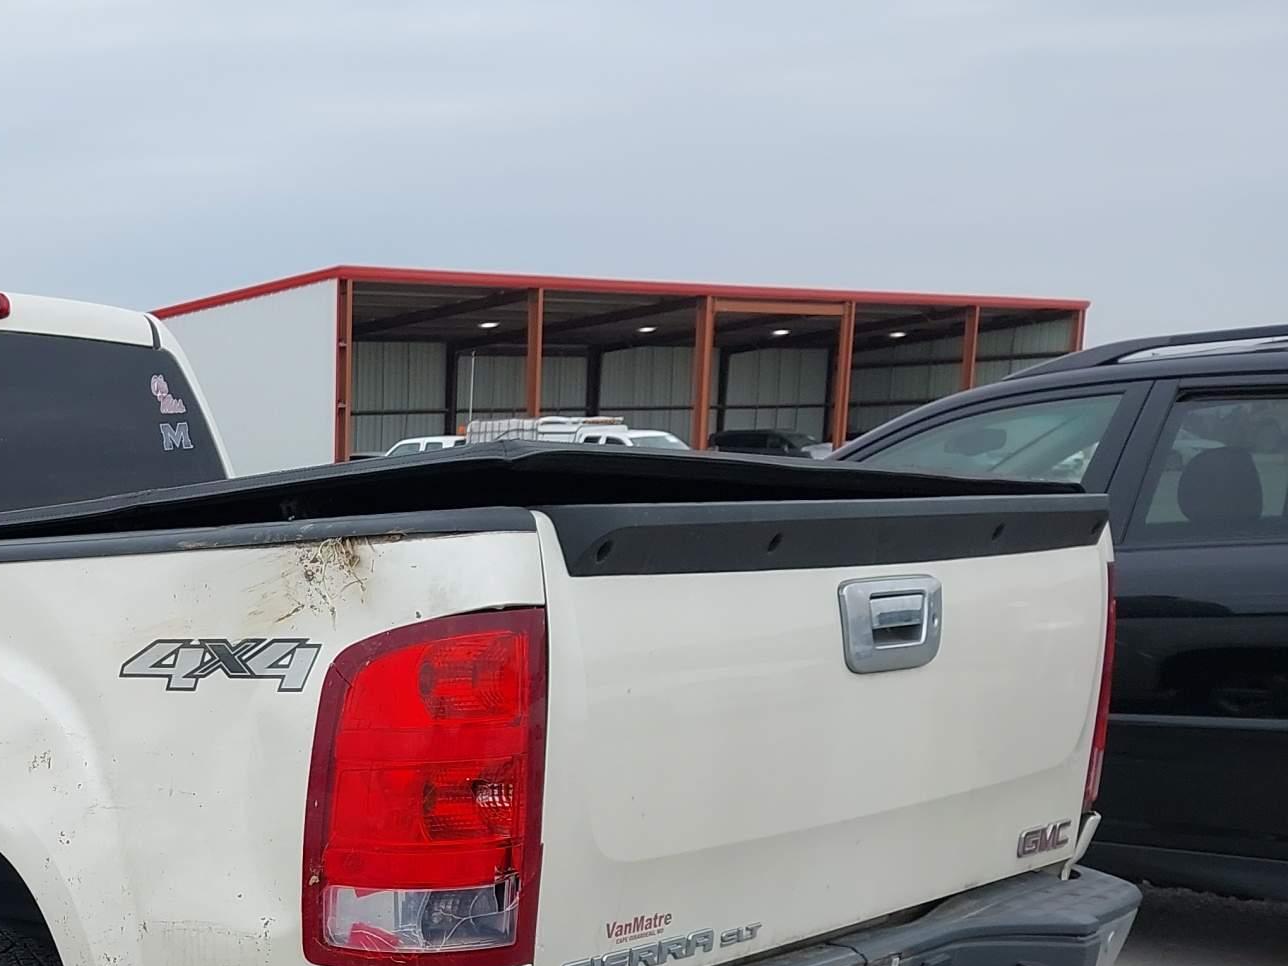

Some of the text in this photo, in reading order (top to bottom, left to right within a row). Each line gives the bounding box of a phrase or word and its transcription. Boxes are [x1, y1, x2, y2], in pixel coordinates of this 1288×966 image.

[160, 422, 193, 450] M
[1016, 819, 1072, 859] GMC
[606, 912, 673, 939] VanMatre
[720, 921, 763, 948] SLT
